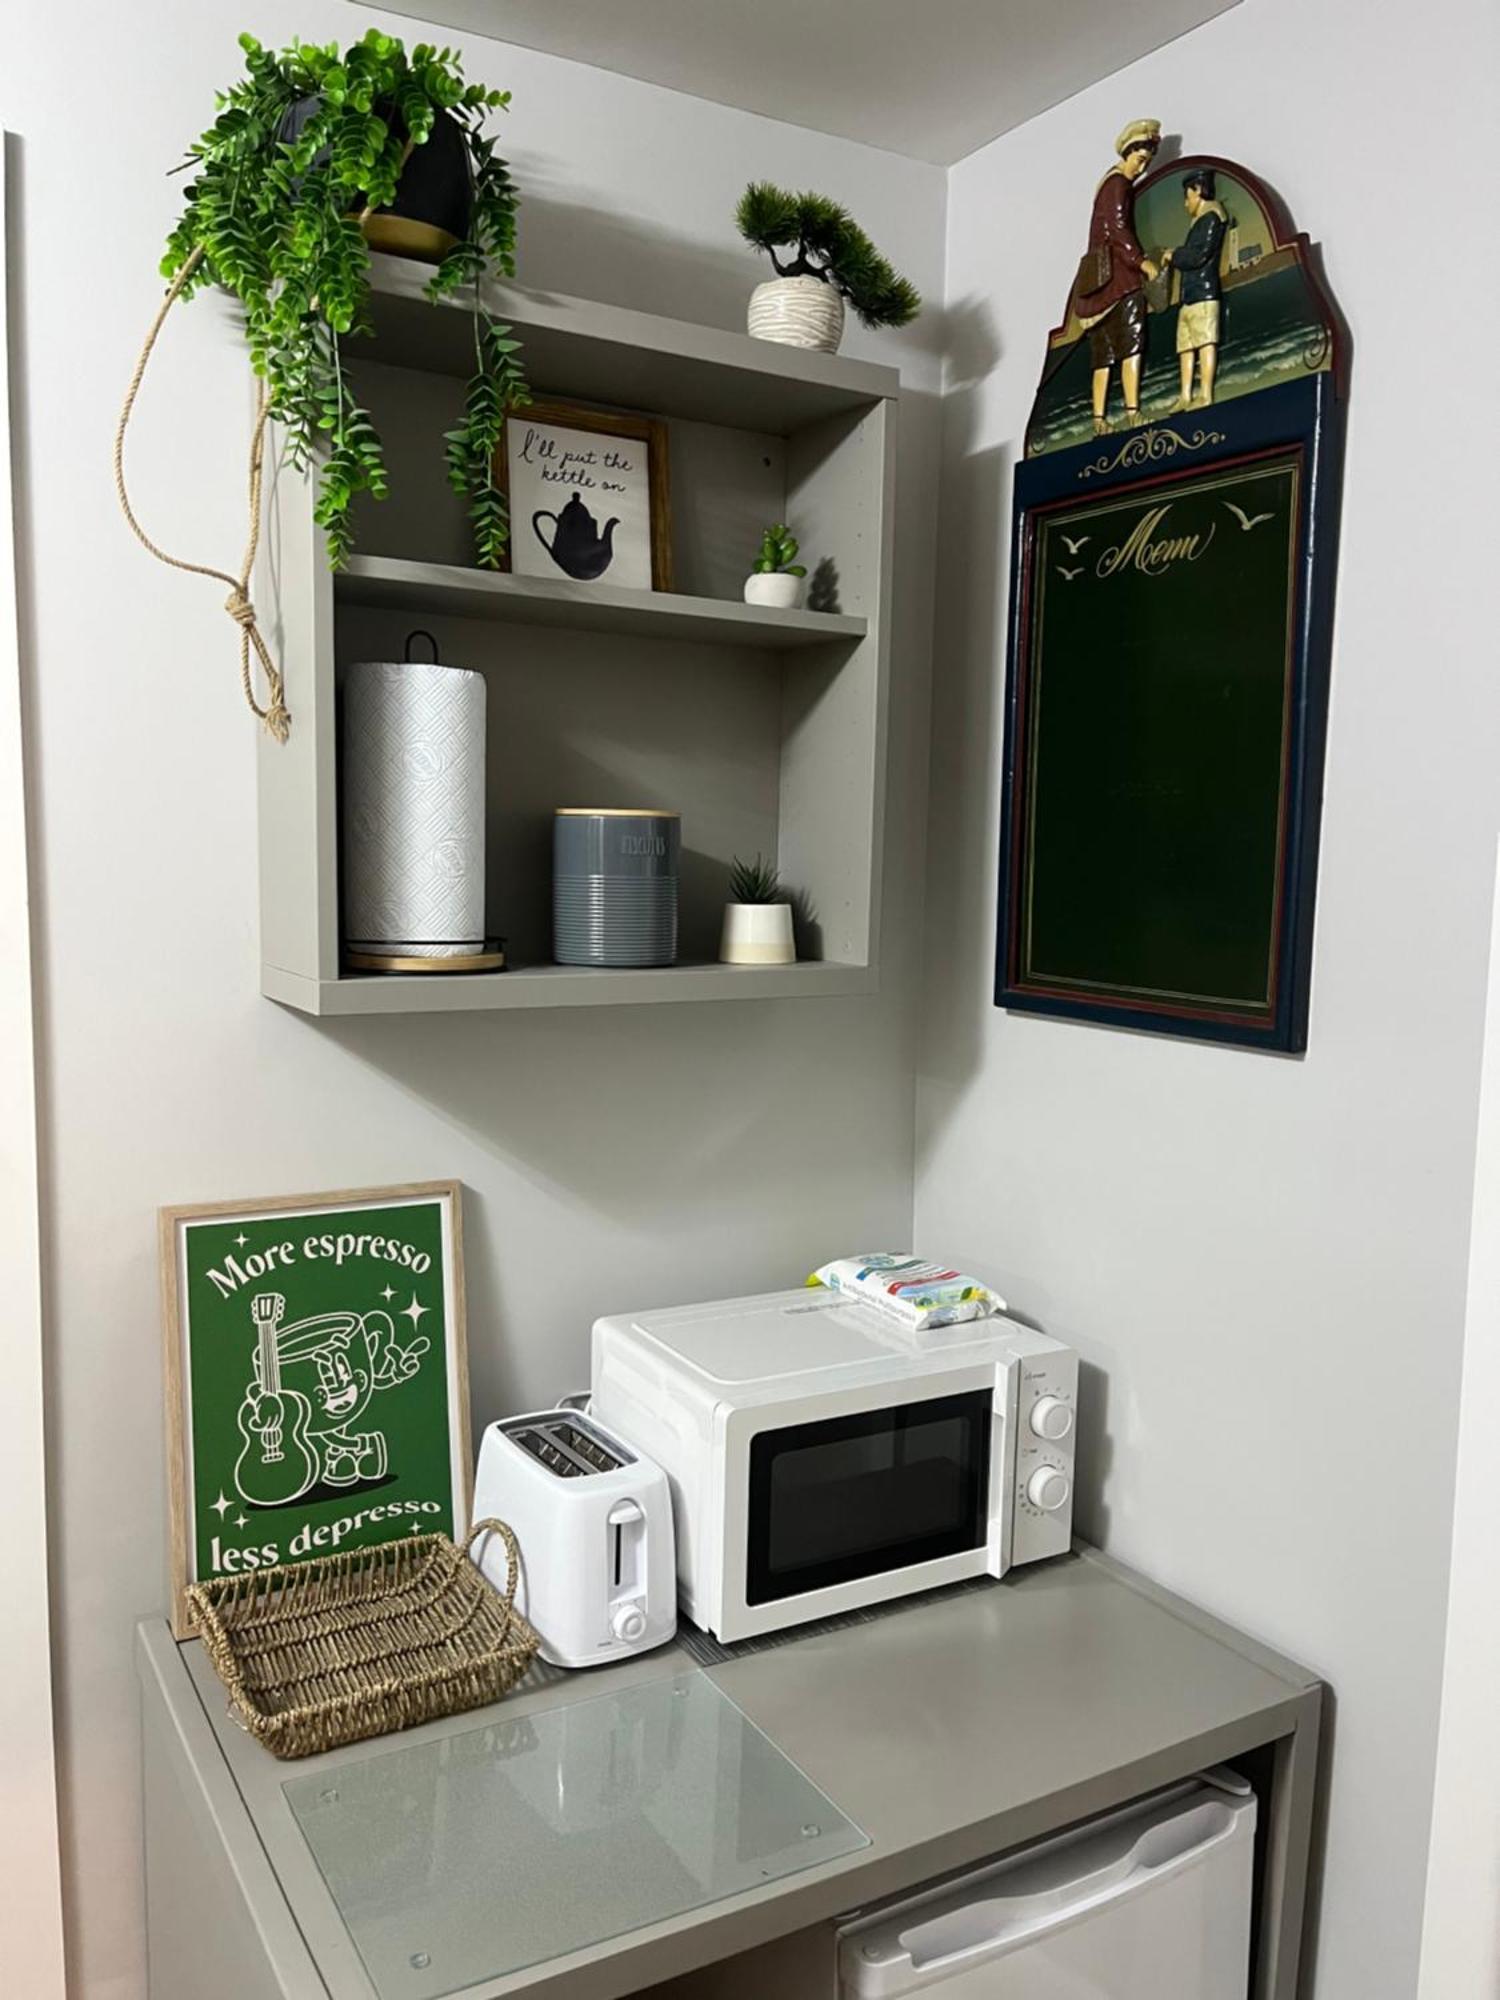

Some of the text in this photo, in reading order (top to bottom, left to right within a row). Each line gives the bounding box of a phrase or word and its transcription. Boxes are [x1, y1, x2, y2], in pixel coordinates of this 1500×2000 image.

[518, 428, 632, 471] I'll put the
[541, 464, 626, 492] kettle on
[1096, 503, 1216, 578] Menu
[206, 1233, 431, 1299] More espresso
[210, 1500, 442, 1573] less depresso
